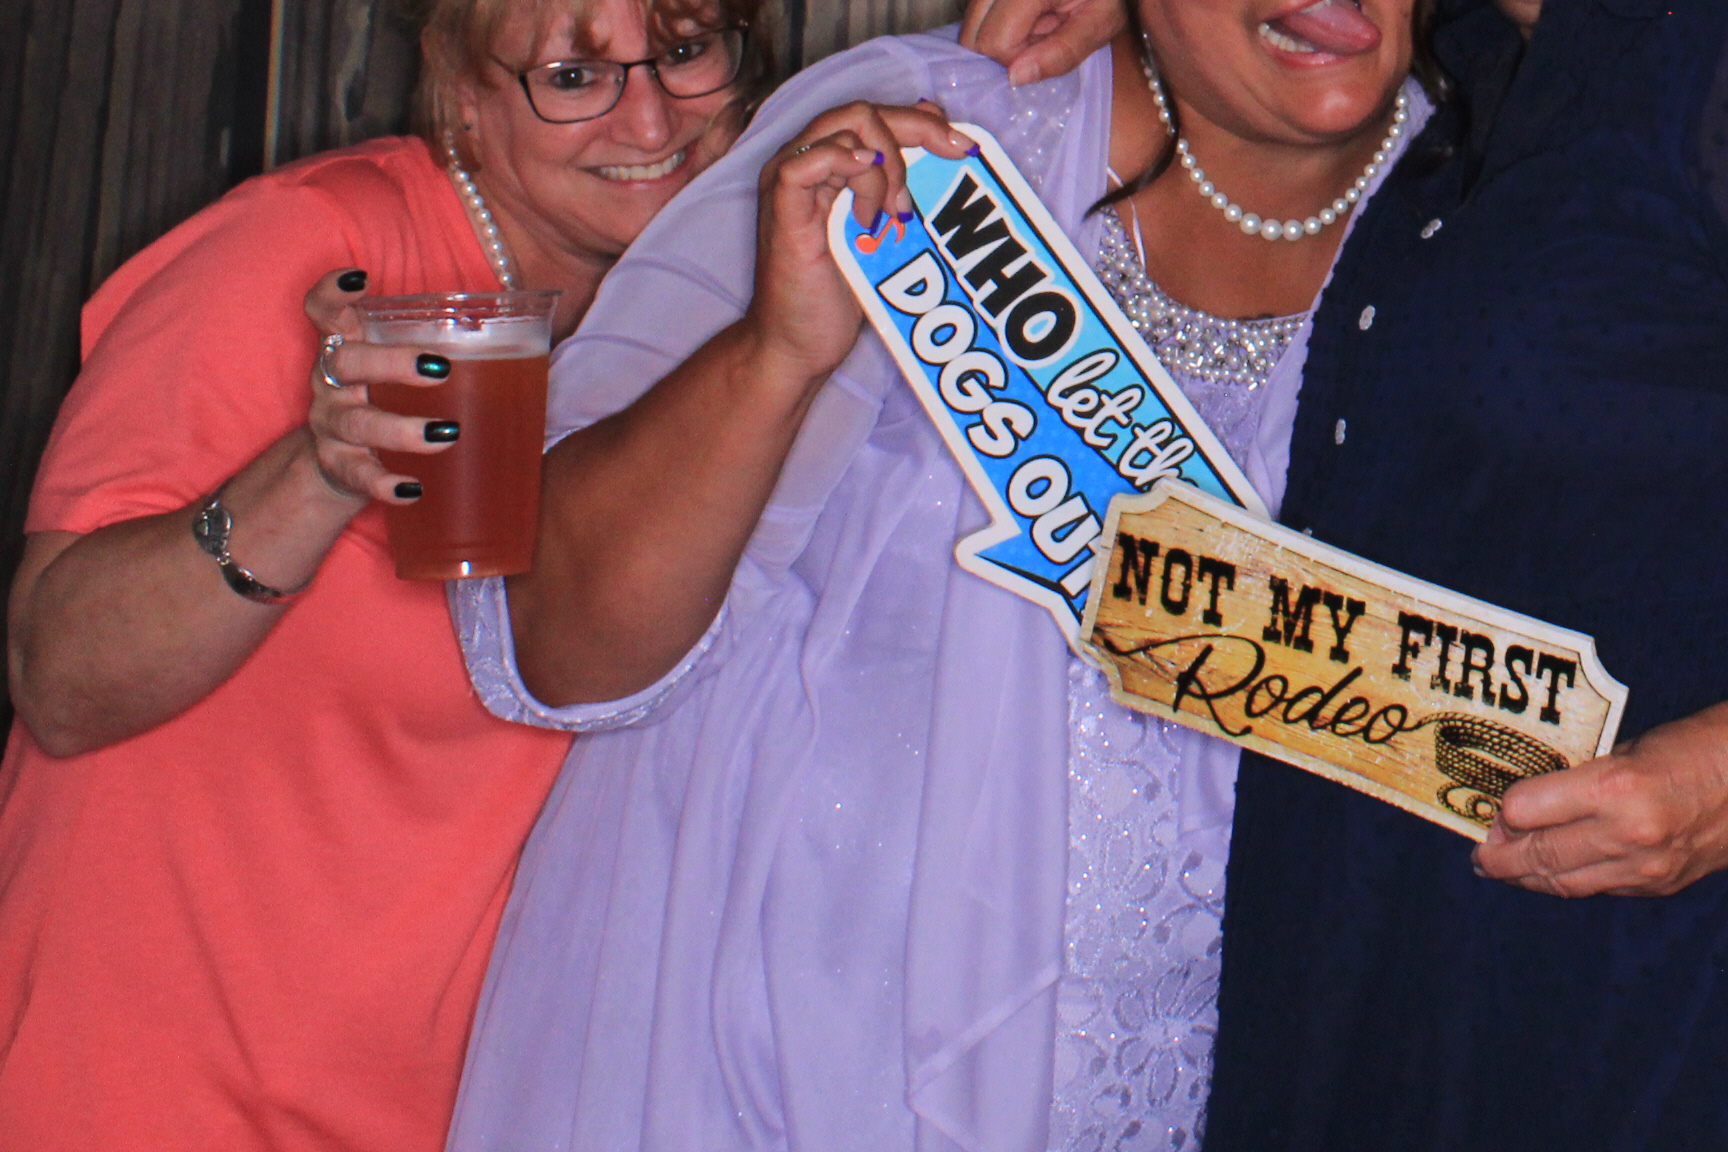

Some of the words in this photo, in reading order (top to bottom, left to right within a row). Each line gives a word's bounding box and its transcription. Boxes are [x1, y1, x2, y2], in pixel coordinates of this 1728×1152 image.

[875, 248, 1038, 459] DOGS
[929, 171, 1078, 363] WHO
[1046, 347, 1146, 447] let
[1118, 417, 1200, 493] th
[1103, 634, 1420, 745] Rodeo
[1112, 532, 1236, 627] NOT
[1262, 575, 1366, 663] MY
[1391, 610, 1578, 725] FIRST
